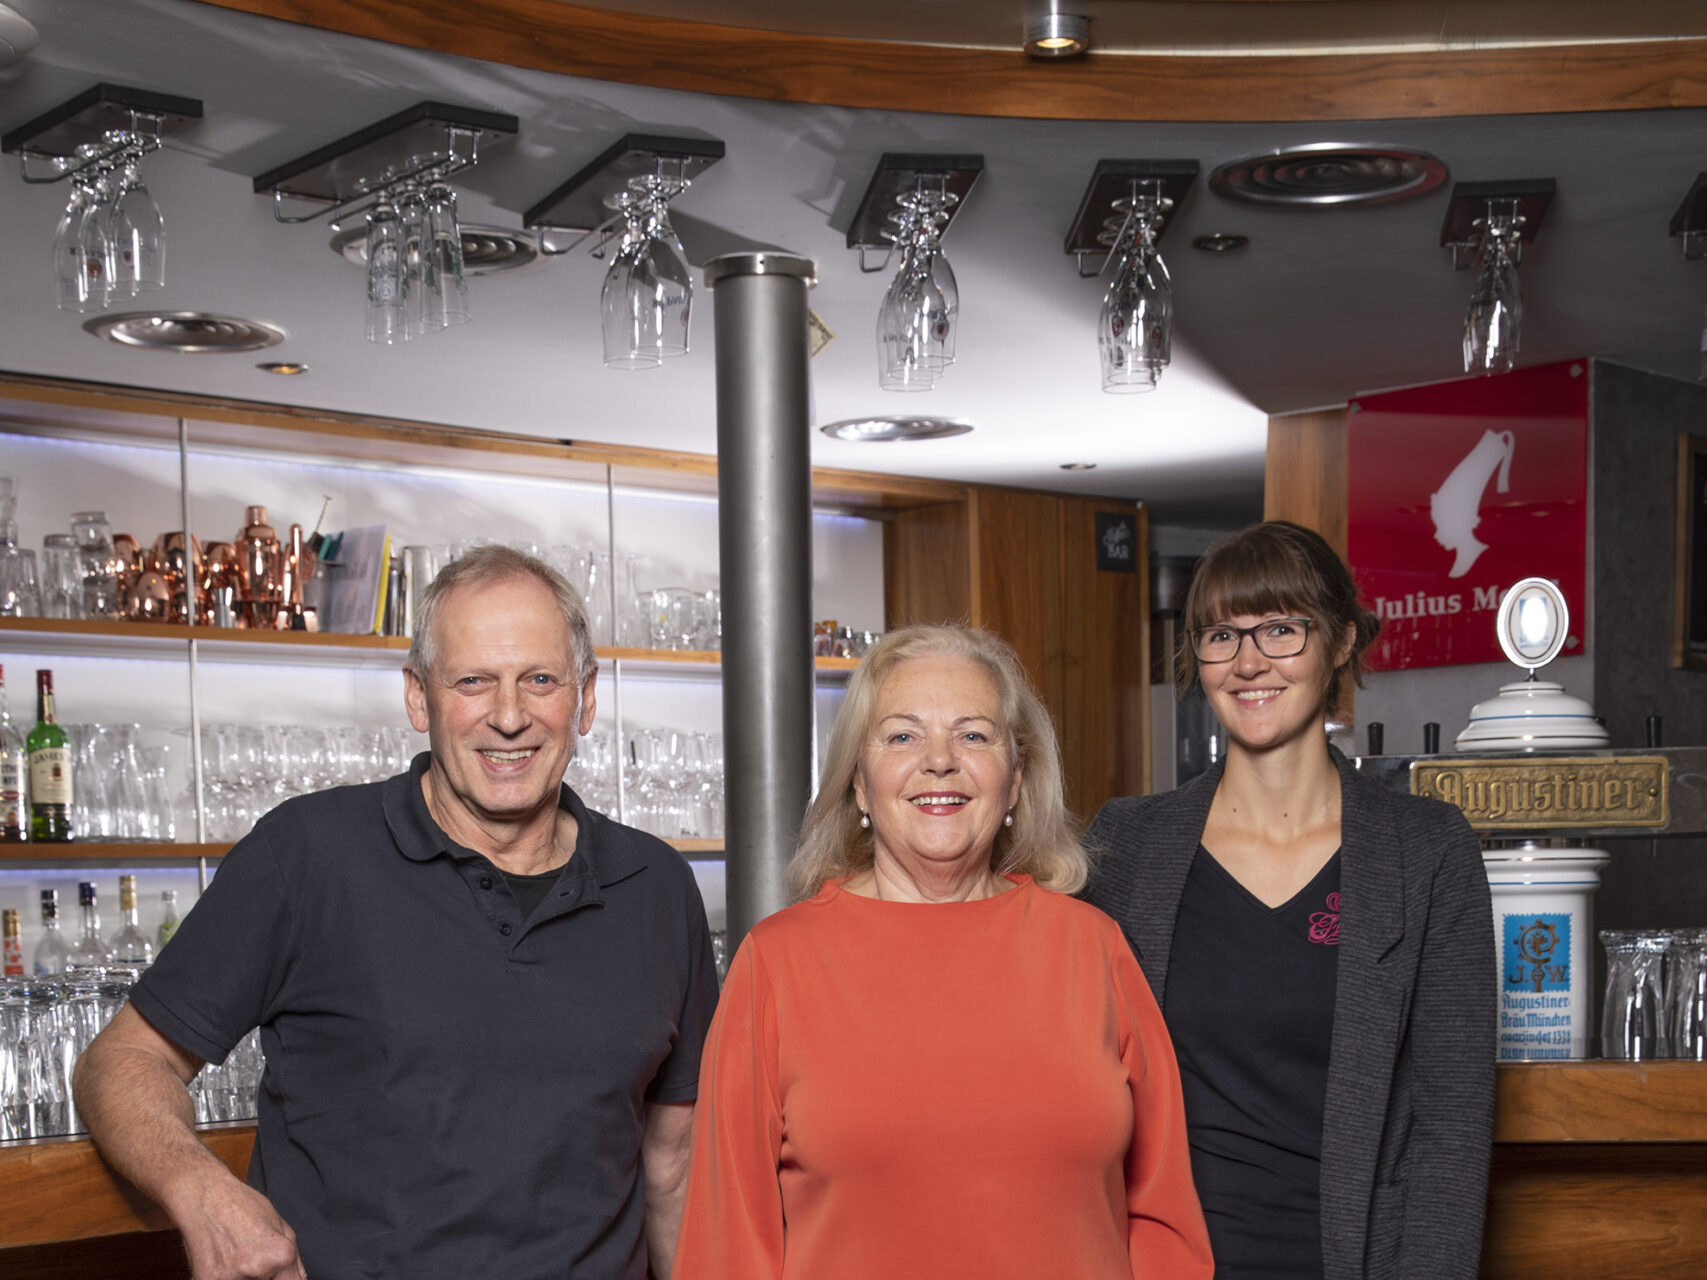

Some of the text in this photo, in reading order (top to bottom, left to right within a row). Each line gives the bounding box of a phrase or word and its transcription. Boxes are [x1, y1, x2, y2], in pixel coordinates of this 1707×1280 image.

[1371, 591, 1462, 620] Julius
[1435, 770, 1644, 819] Augustiner
[1501, 1011, 1526, 1028] Bräu
